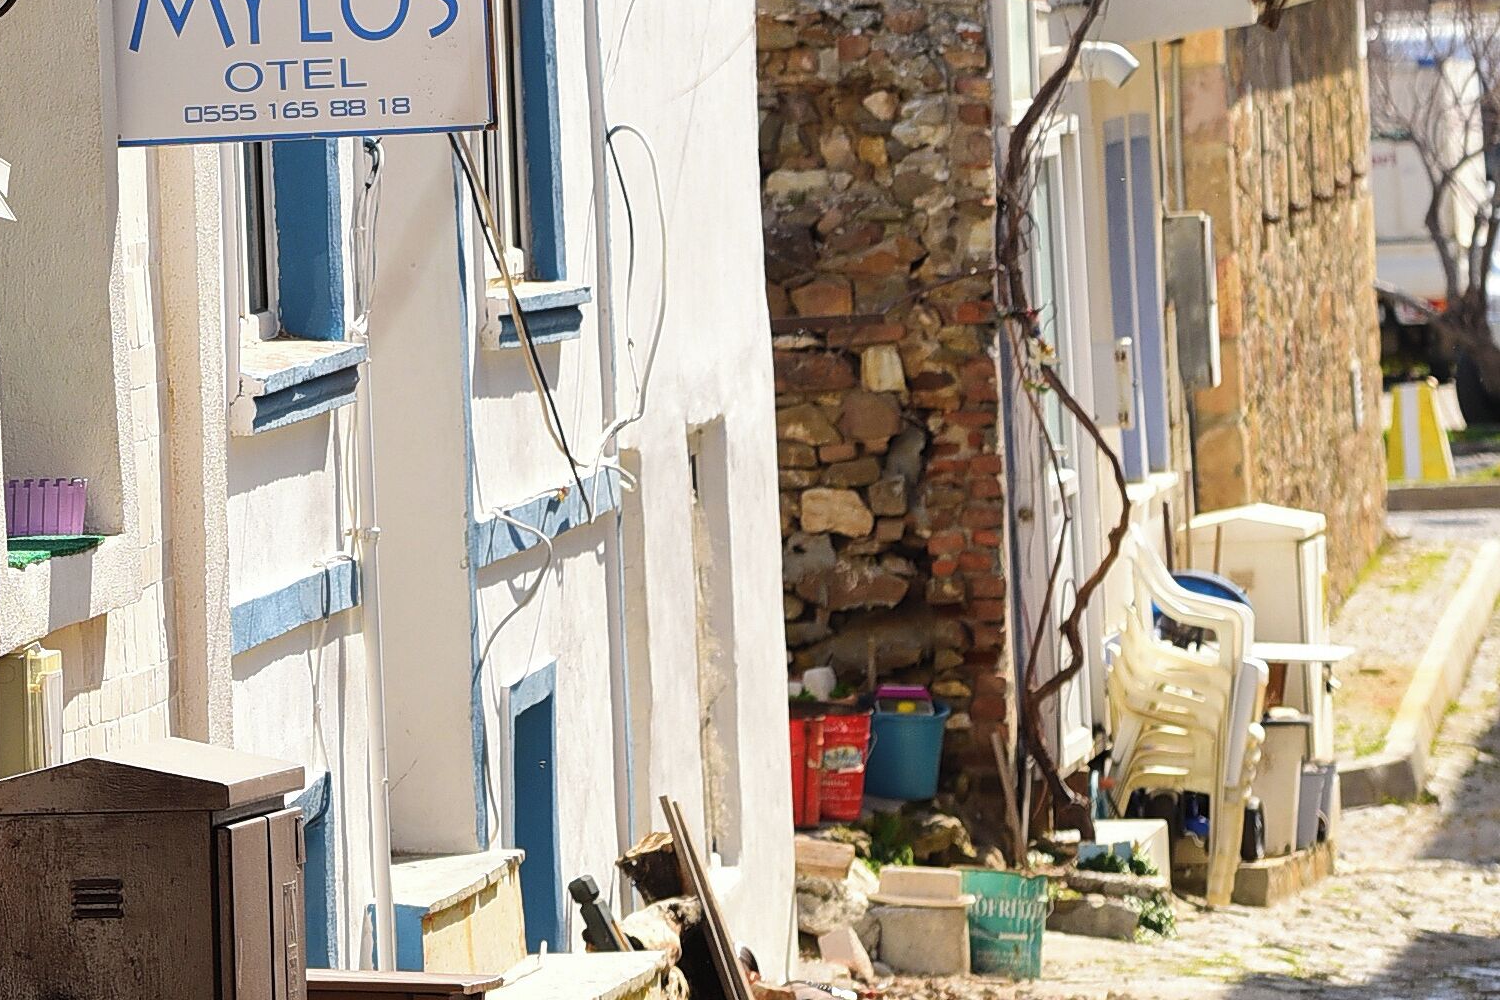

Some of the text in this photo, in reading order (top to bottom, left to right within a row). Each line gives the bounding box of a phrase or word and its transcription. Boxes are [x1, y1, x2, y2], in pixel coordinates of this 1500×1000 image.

[224, 58, 368, 93] OTEL
[184, 97, 412, 124] 0555 165 88 18
